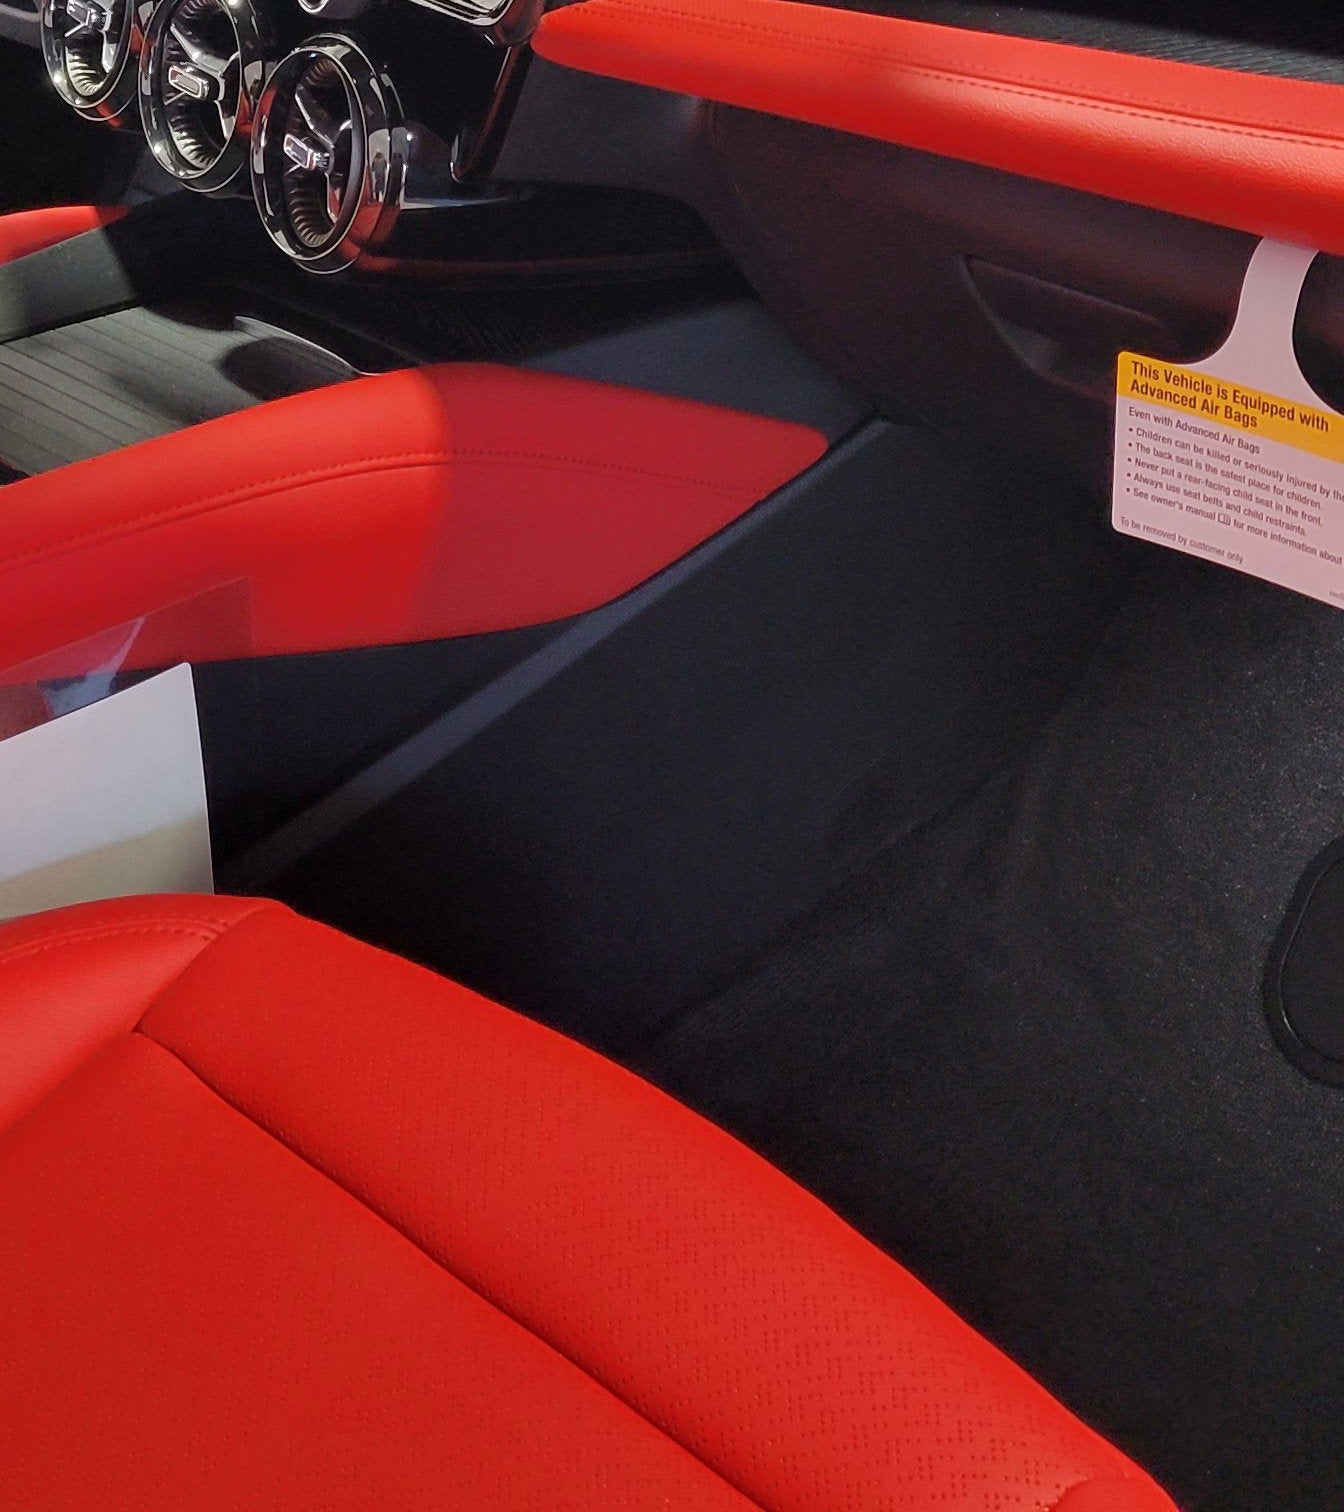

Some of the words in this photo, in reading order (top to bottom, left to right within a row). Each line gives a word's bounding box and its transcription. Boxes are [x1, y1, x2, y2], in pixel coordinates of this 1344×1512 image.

[1131, 379, 1196, 408] Advanced
[1201, 399, 1220, 415] Air
[1224, 406, 1258, 428] Bags
[1132, 360, 1159, 380] This
[1164, 369, 1212, 395] Vehicle
[1217, 384, 1228, 400] is
[1233, 390, 1295, 420] Equipped
[1300, 412, 1328, 432] with
[1129, 406, 1150, 421] Even
[1154, 414, 1172, 427] with
[1176, 420, 1220, 440] Advanced
[1222, 434, 1235, 445] Air
[1238, 438, 1260, 454] Bags
[1136, 428, 1172, 445] Children
[1175, 440, 1190, 450] can
[1194, 444, 1204, 454] be
[1207, 448, 1230, 462] killed
[1233, 458, 1242, 466] or
[1244, 462, 1284, 482] seriously
[1287, 474, 1316, 492] injured
[1320, 485, 1330, 498] by
[1136, 442, 1150, 454] The
[1153, 449, 1172, 460] back
[1176, 456, 1192, 466] seat
[1196, 462, 1202, 470] is
[1205, 464, 1218, 474] the
[1221, 470, 1245, 484] safest
[1248, 478, 1270, 492] place
[1274, 486, 1284, 496] for
[1134, 473, 1163, 488] Always
[1166, 484, 1180, 494] use
[1183, 489, 1200, 500] seat
[1203, 494, 1223, 508] belts
[1226, 502, 1241, 514] and
[1244, 508, 1264, 520] child
[1135, 458, 1159, 471] Never
[1162, 467, 1174, 477] put
[1185, 474, 1230, 496] rear-facing
[1232, 489, 1252, 502] child
[1256, 496, 1272, 508] seat
[1276, 502, 1283, 512] in
[1286, 505, 1298, 518] the
[1302, 510, 1323, 526] front.
[1121, 516, 1129, 526] To
[1132, 520, 1140, 530] be
[1143, 525, 1176, 540] removed
[1178, 534, 1188, 546] by
[1190, 539, 1225, 556] customer
[1227, 552, 1244, 565] only
[1134, 488, 1148, 500] See
[1151, 494, 1184, 510] owner's
[1186, 505, 1216, 520] manual
[1234, 519, 1244, 530] for
[1247, 525, 1268, 538] more
[1270, 532, 1316, 555] information
[1320, 550, 1342, 565] about
